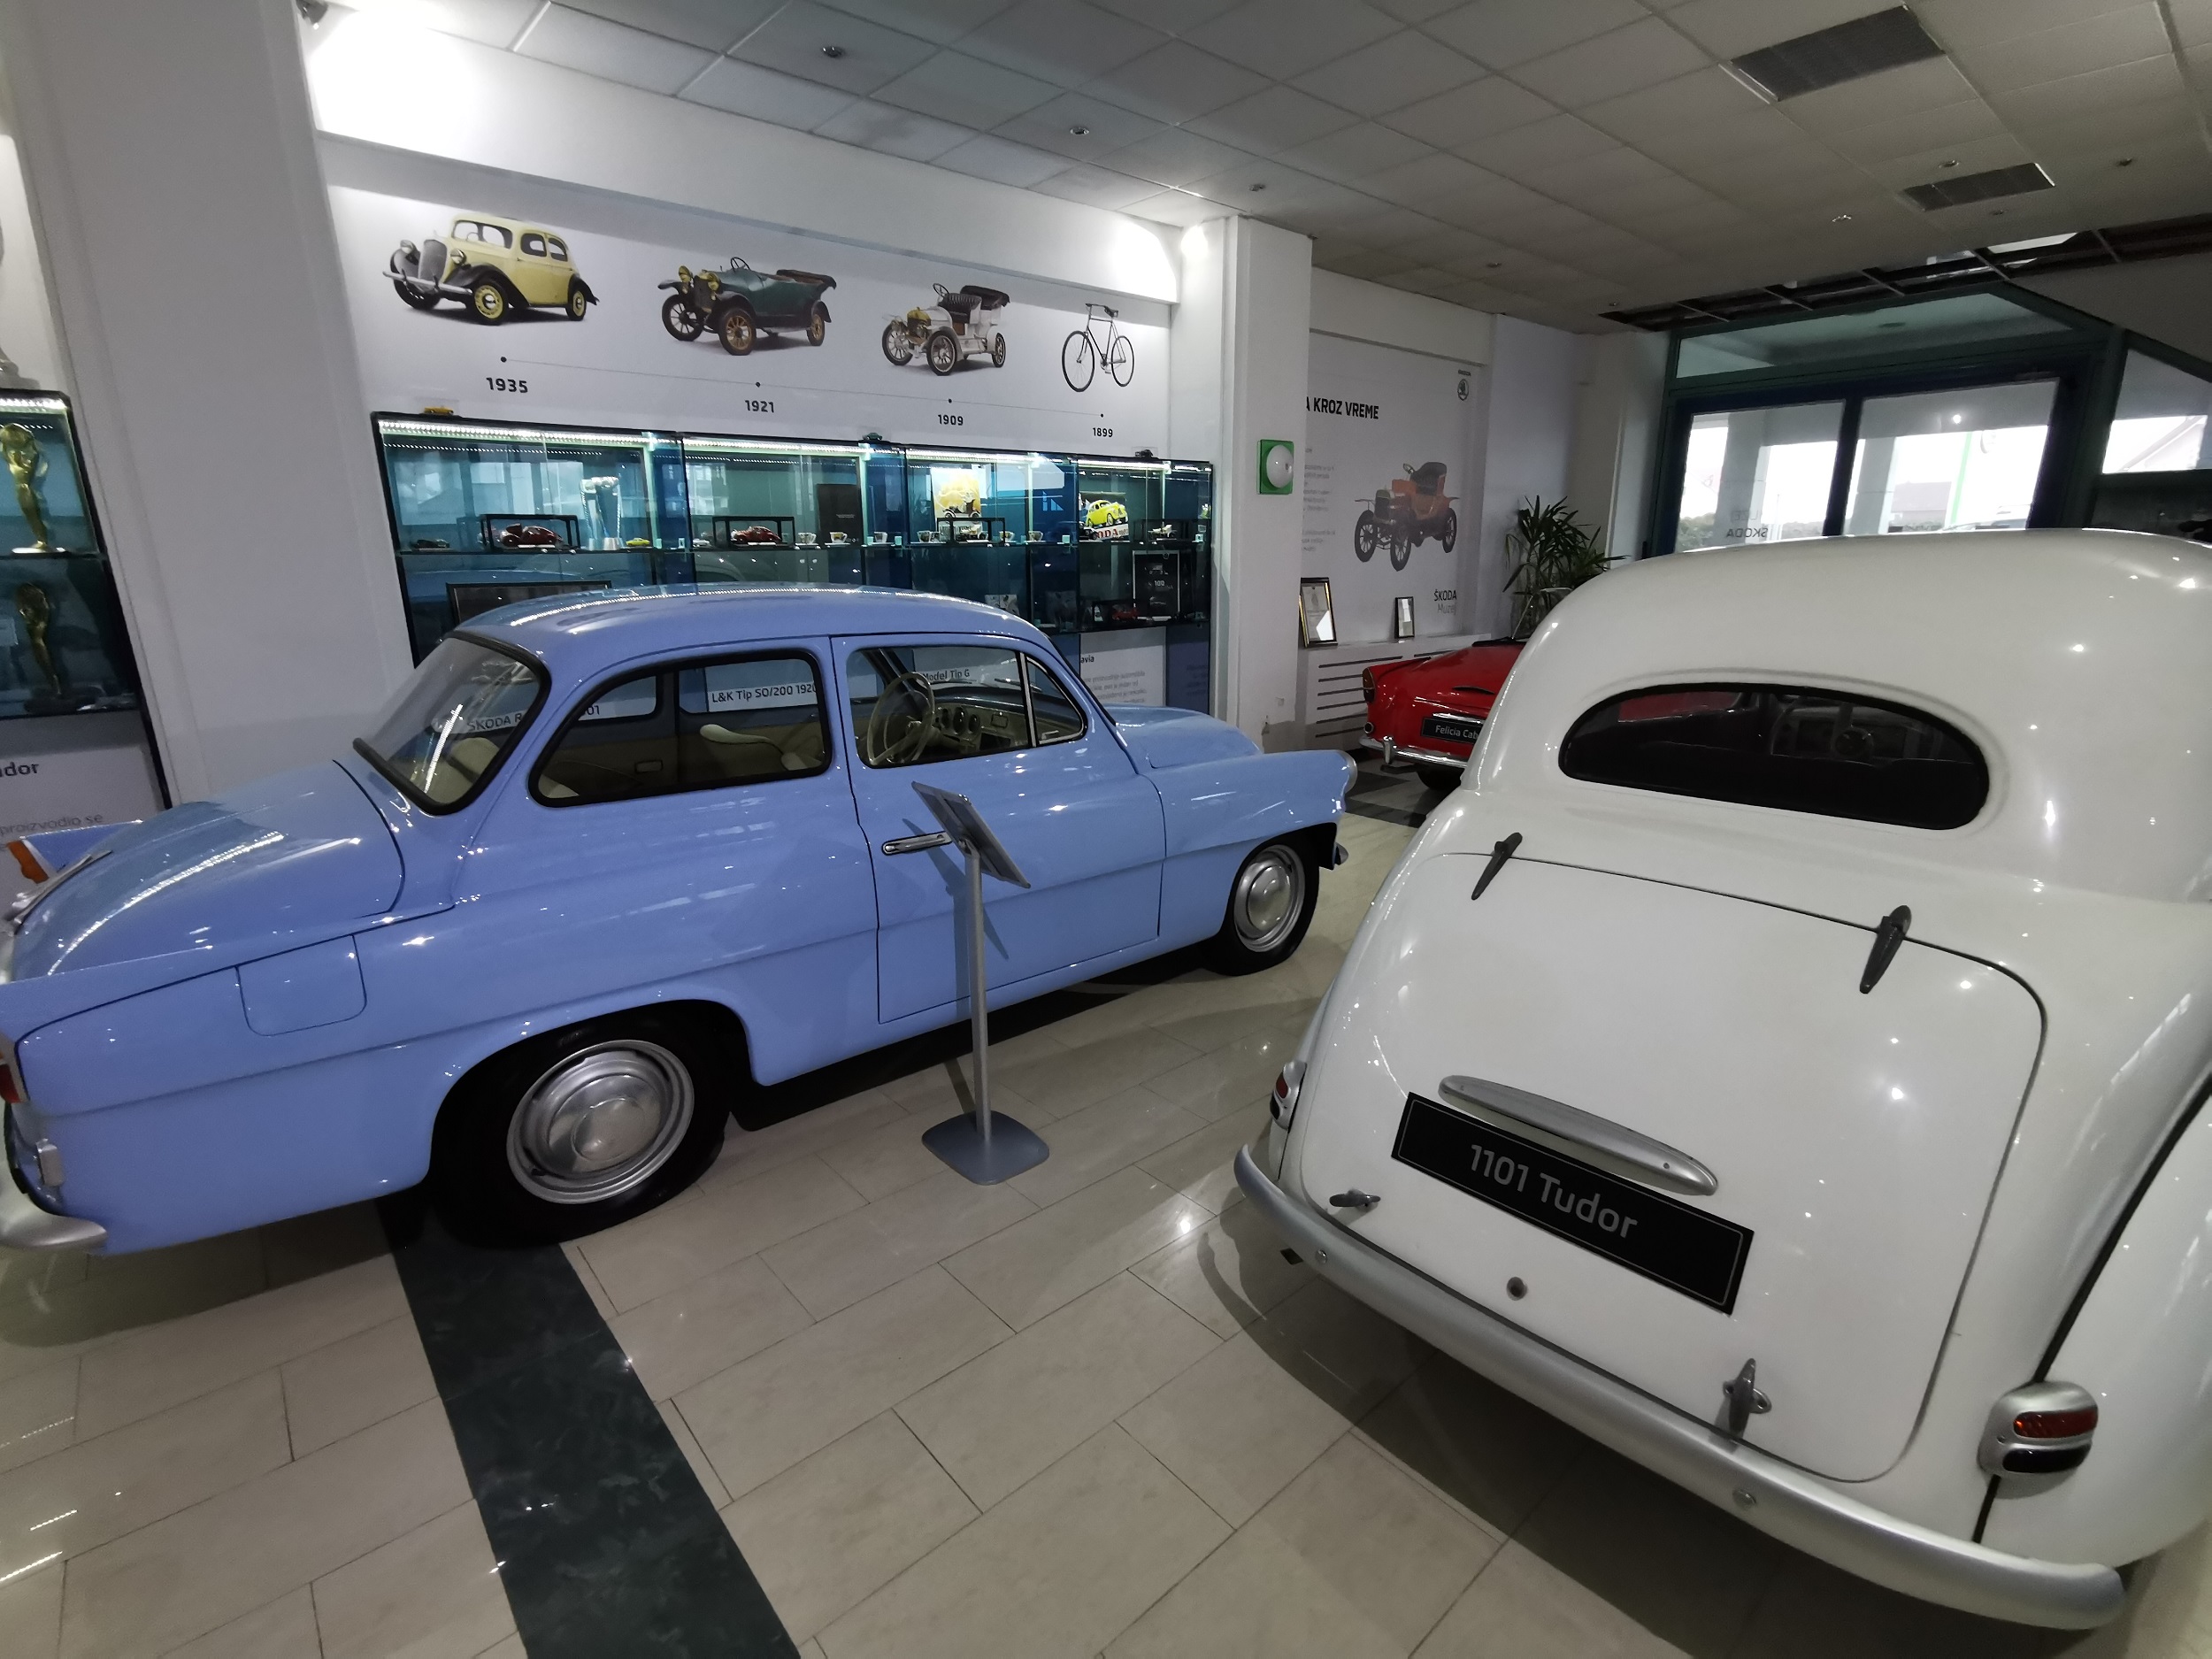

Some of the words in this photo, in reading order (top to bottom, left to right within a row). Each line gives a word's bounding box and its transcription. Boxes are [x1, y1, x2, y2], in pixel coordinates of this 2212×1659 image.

[486, 377, 528, 394] 1935
[744, 399, 775, 413] 1921
[1313, 396, 1342, 416] KROZ
[1345, 401, 1379, 420] VREME
[937, 413, 964, 426] 1909
[1092, 426, 1114, 438] 1899
[711, 690, 734, 703] L&K
[736, 687, 753, 702] Tip
[1435, 725, 1461, 737] Felicia
[1471, 1144, 1530, 1193] 1101
[1540, 1172, 1638, 1239] Tudor
